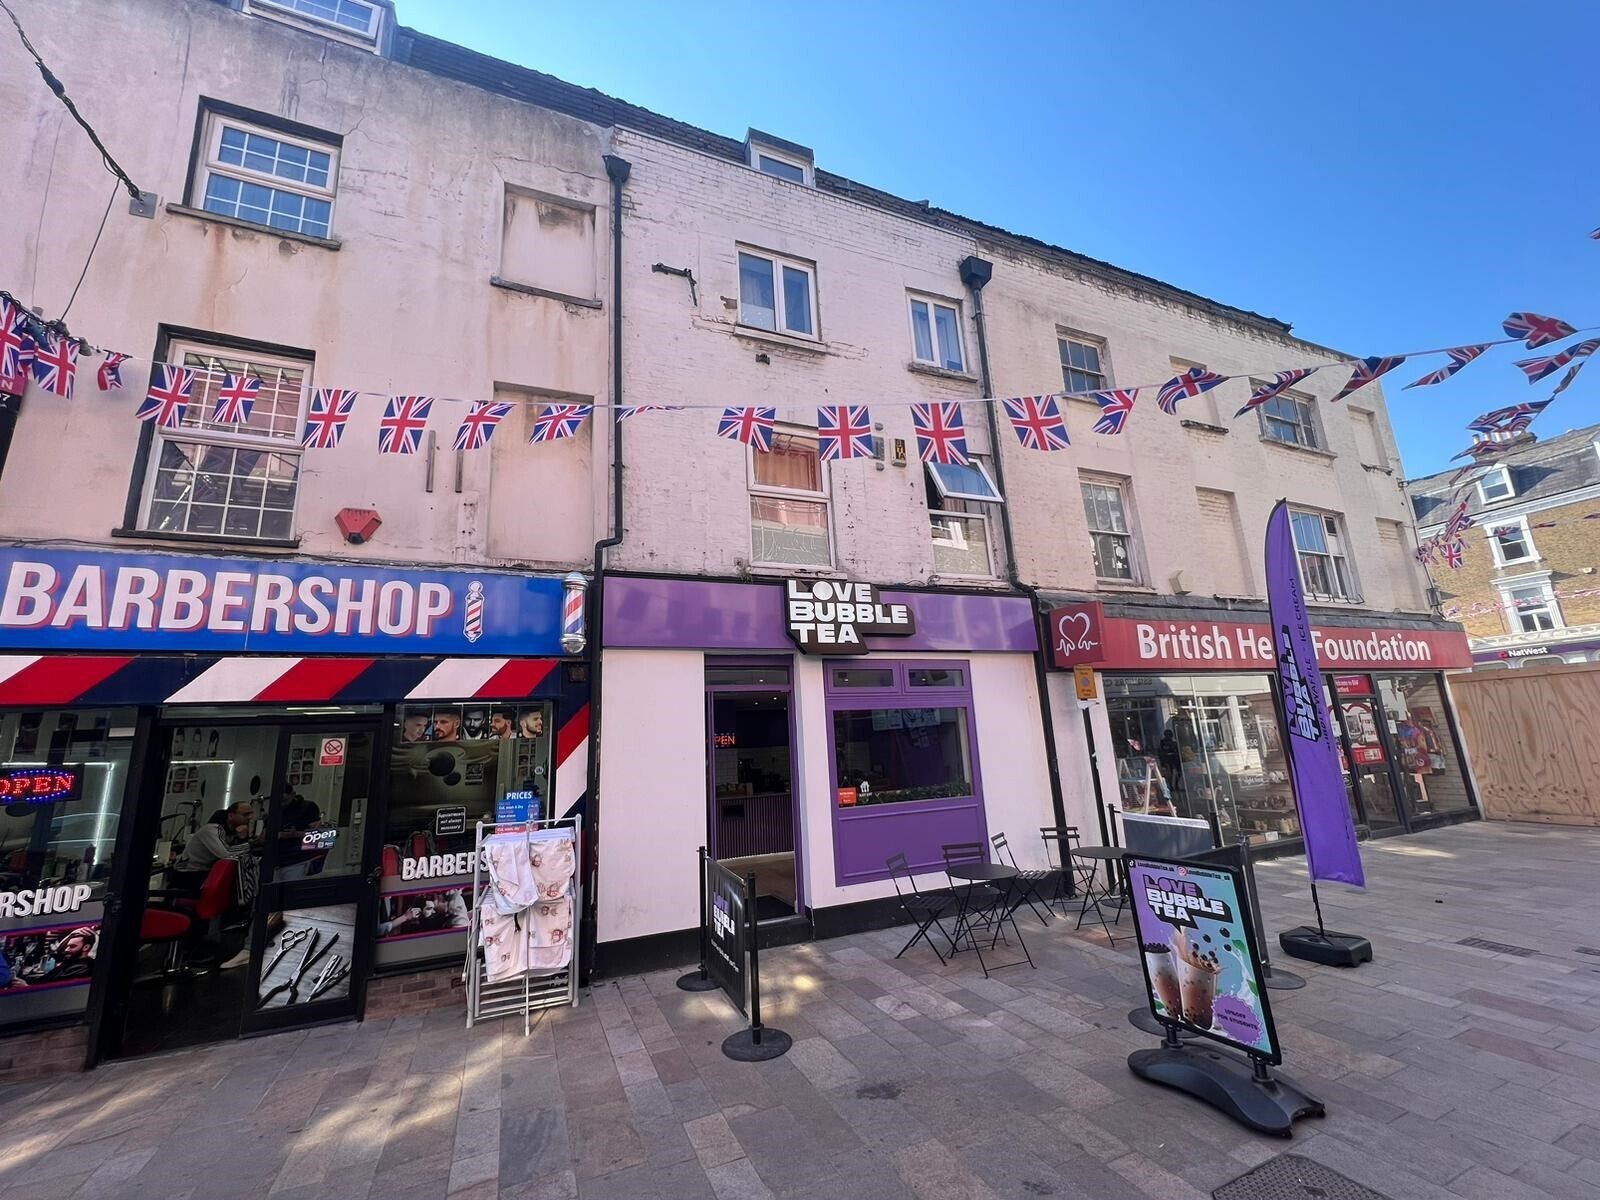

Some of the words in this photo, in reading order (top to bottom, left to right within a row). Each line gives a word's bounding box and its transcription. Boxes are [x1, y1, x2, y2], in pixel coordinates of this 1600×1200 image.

[0, 561, 453, 636] BARBERSHOP
[788, 580, 872, 602] LOVE
[1289, 578, 1302, 621] CREAM
[789, 601, 908, 624] BUBBLE
[790, 623, 860, 643] TEA
[1137, 624, 1232, 660] British
[1236, 628, 1274, 660] He
[1310, 630, 1431, 661] Foundation
[1298, 624, 1307, 642] ICE
[1508, 646, 1548, 657] NatWest
[1281, 662, 1301, 736] LOVE
[506, 791, 533, 800] PRICES
[303, 830, 337, 844] Open
[1143, 874, 1198, 896] LOVE
[1146, 888, 1225, 915] BUBBLE
[1149, 901, 1191, 921] TEA
